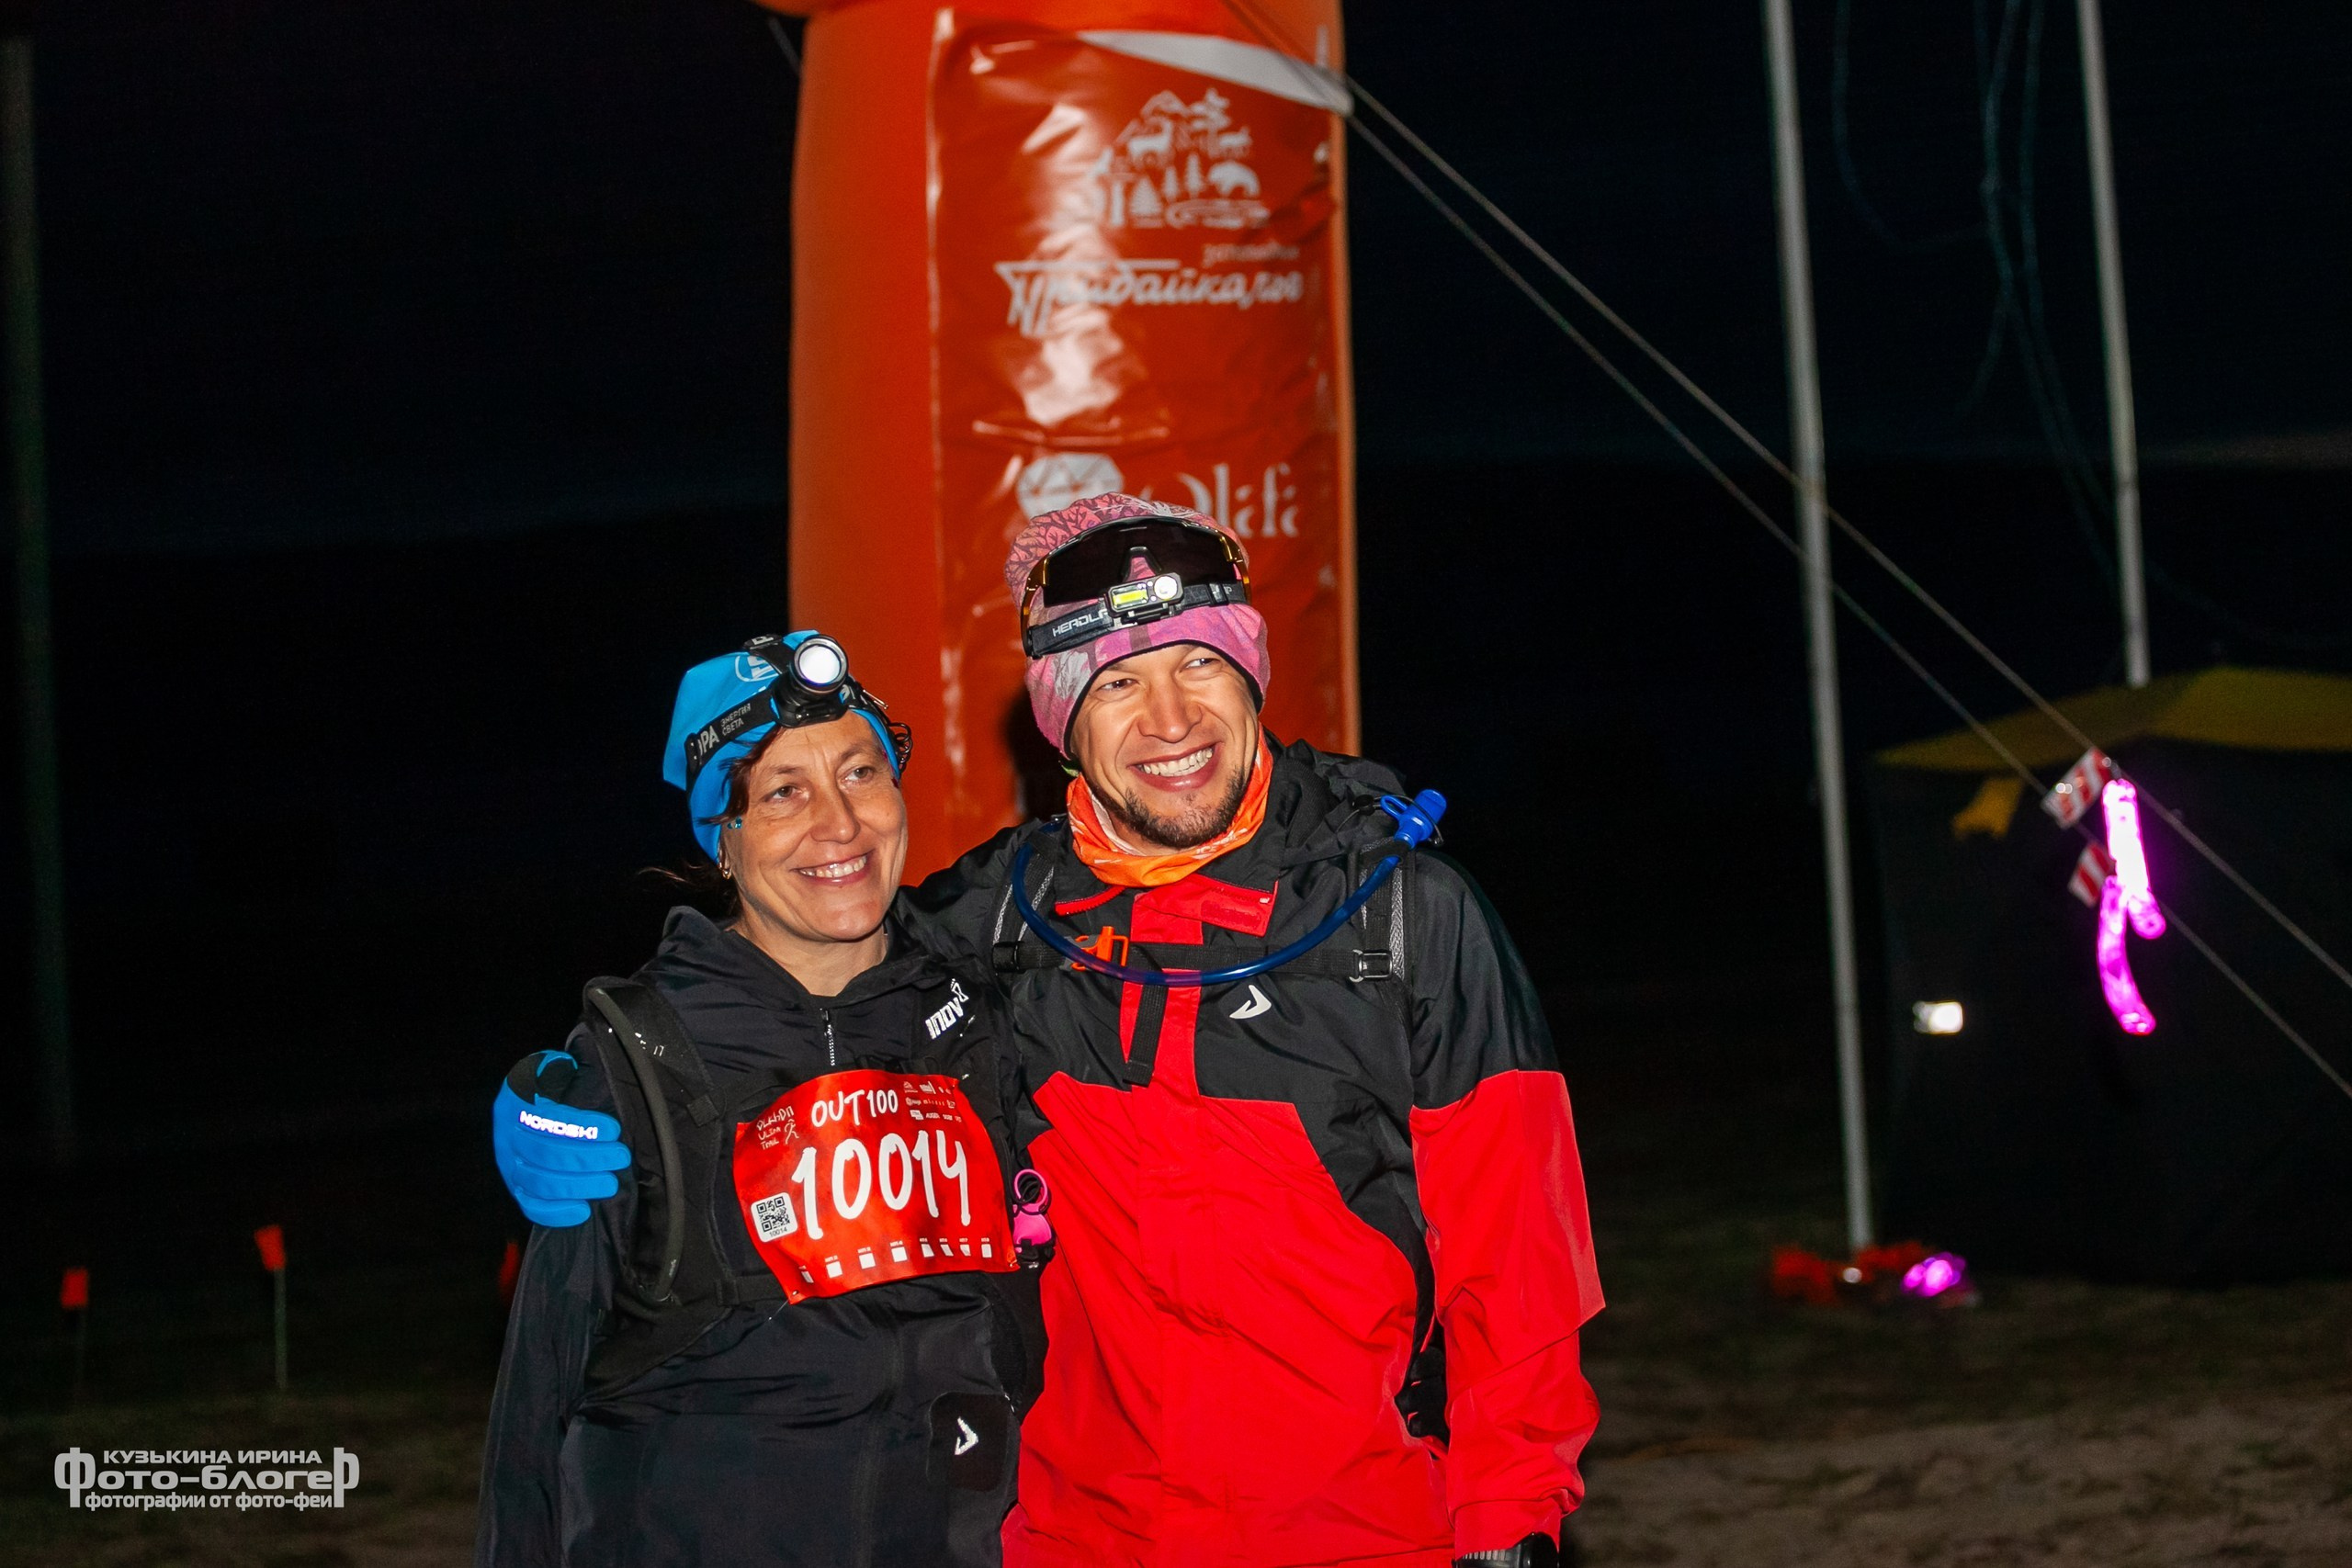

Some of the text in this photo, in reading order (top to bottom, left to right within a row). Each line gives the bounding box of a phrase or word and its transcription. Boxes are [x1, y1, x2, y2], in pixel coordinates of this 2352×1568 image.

[721, 717, 745, 737] СВЕТА
[810, 1089, 899, 1127] OUT100
[519, 1111, 598, 1140] NORDSKI
[791, 1129, 971, 1240] 10014
[769, 1226, 787, 1237] 10014
